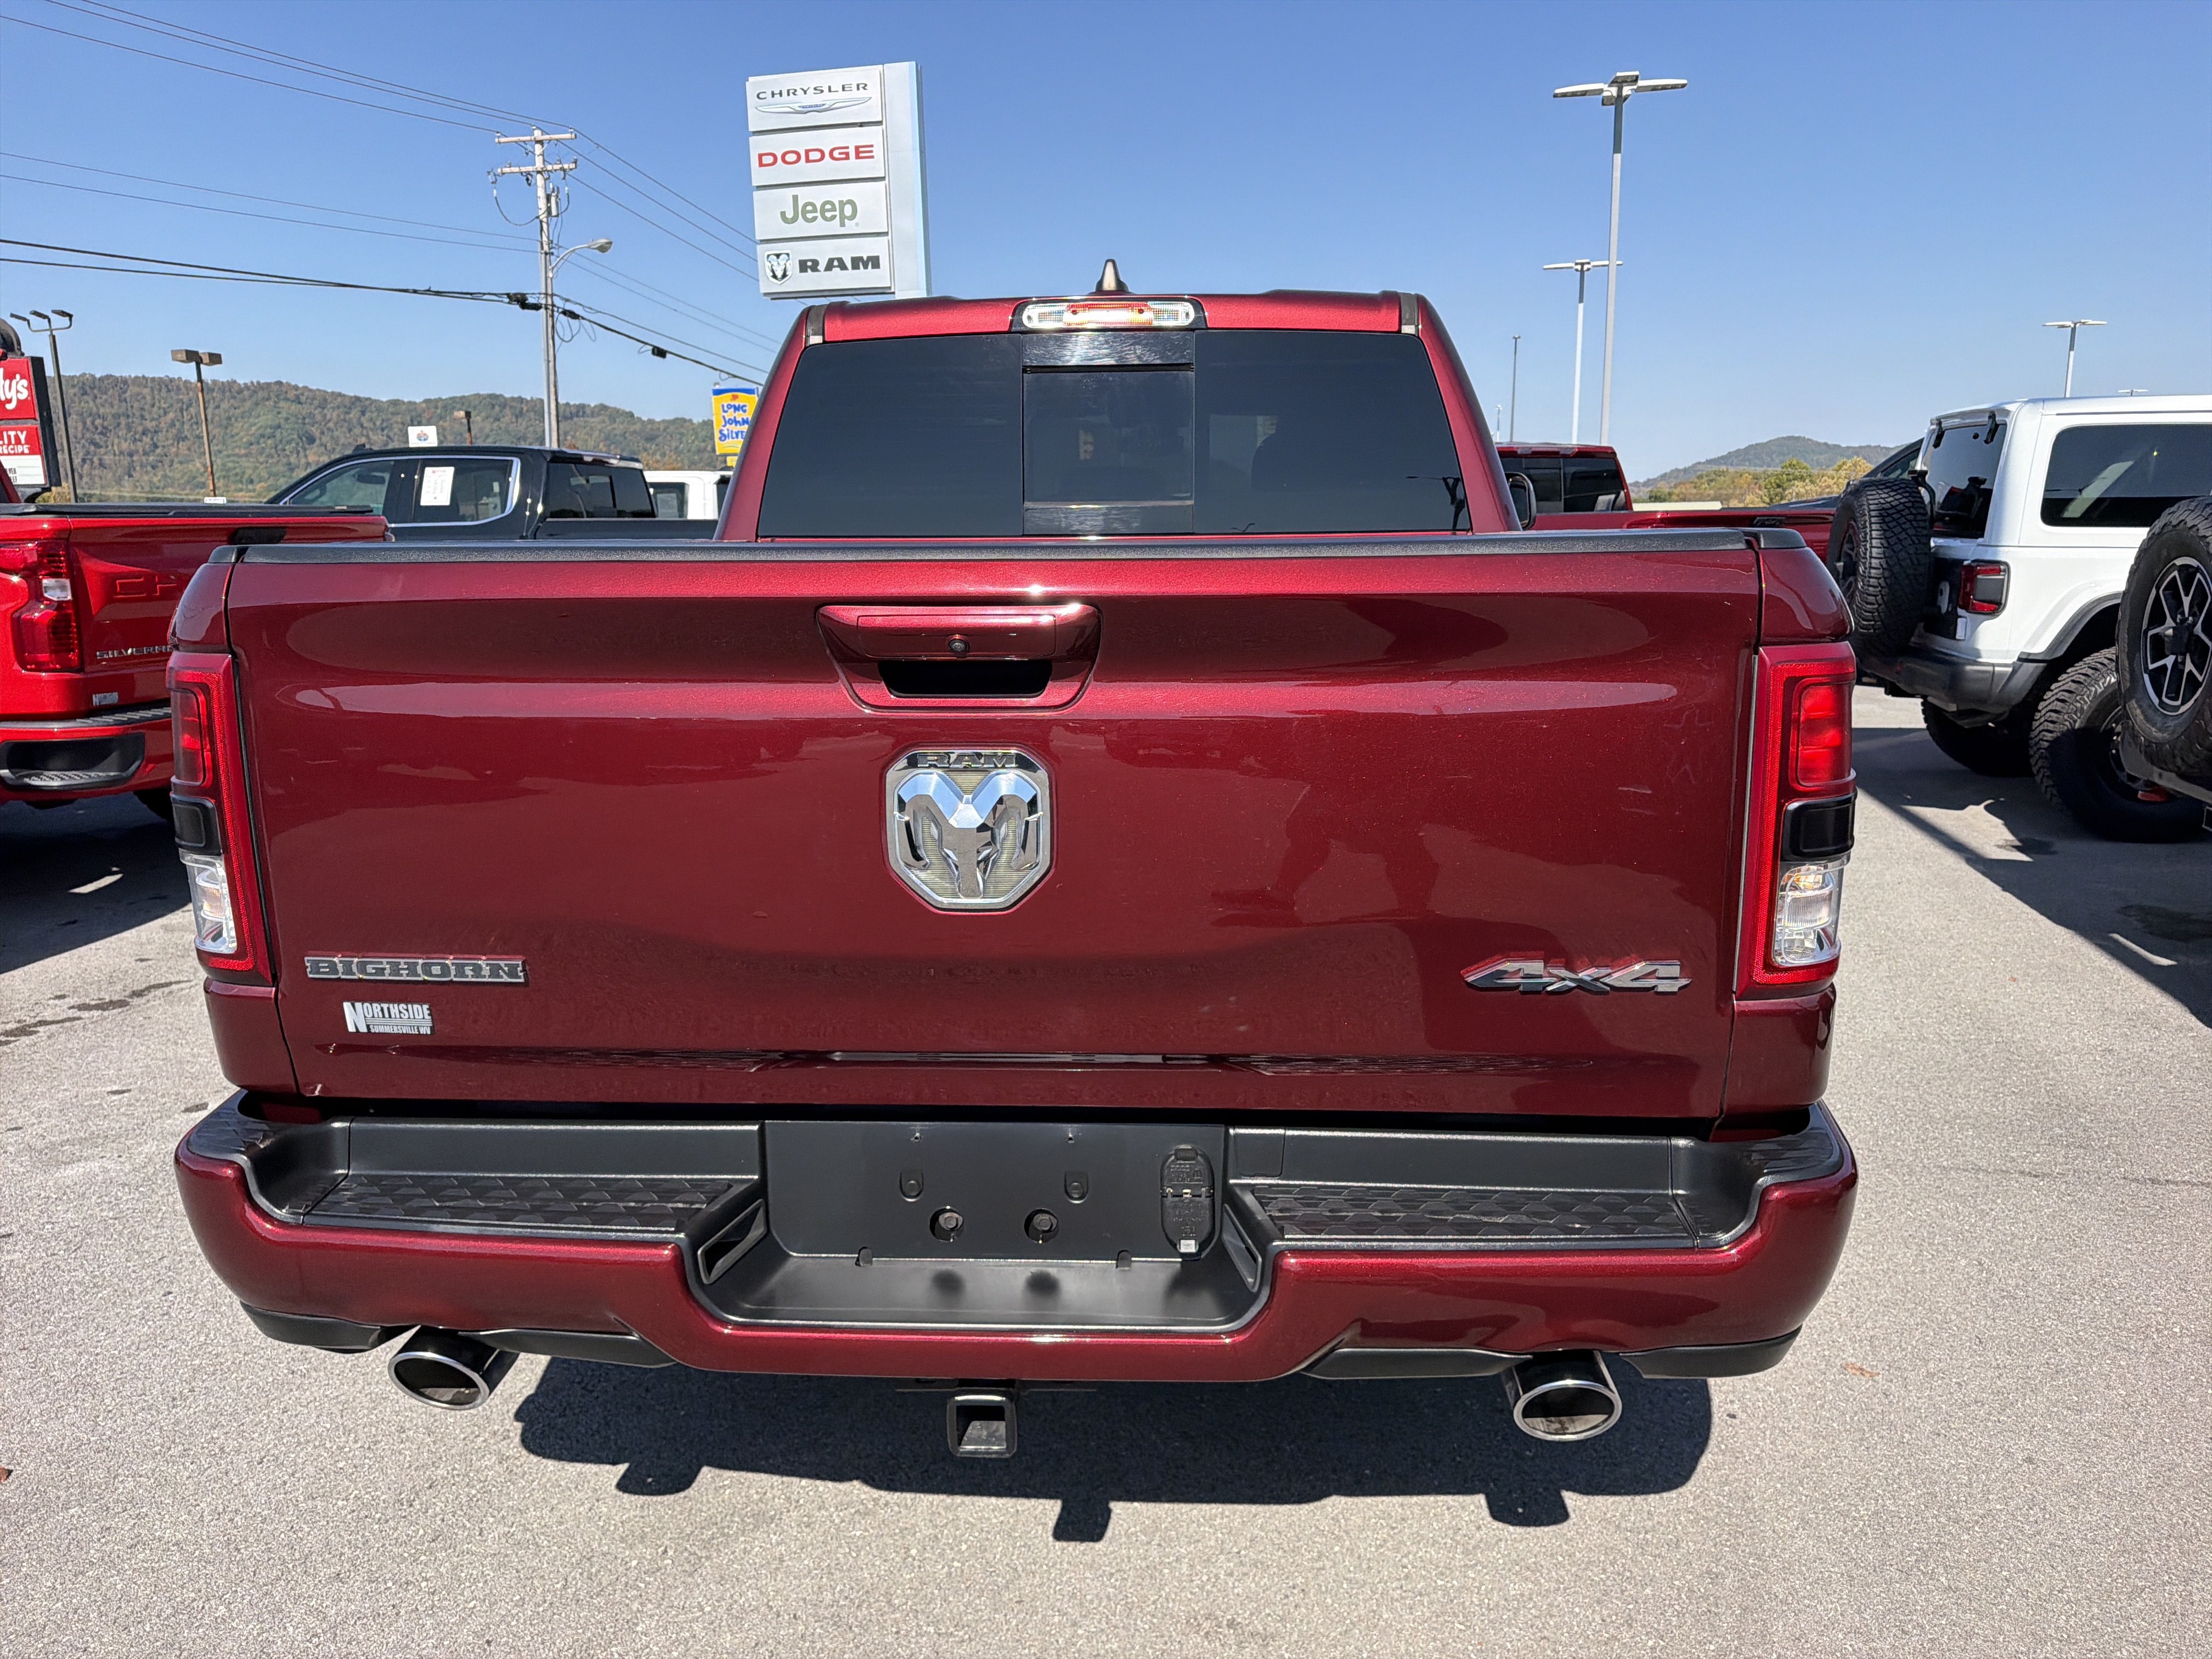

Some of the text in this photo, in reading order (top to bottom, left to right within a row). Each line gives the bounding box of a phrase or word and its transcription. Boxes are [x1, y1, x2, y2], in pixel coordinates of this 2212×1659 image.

[757, 83, 868, 100] CHRYSLER
[758, 144, 875, 167] DODGE
[780, 194, 857, 227] Jeep
[798, 255, 881, 273] RAM
[721, 403, 747, 413] LONG
[719, 428, 746, 442] SILVE
[917, 754, 1015, 768] RAM
[304, 957, 525, 983] BIGHORN
[343, 1002, 432, 1032] NORTHSIDE
[370, 1024, 431, 1035] SUMMERSVILLE WV
